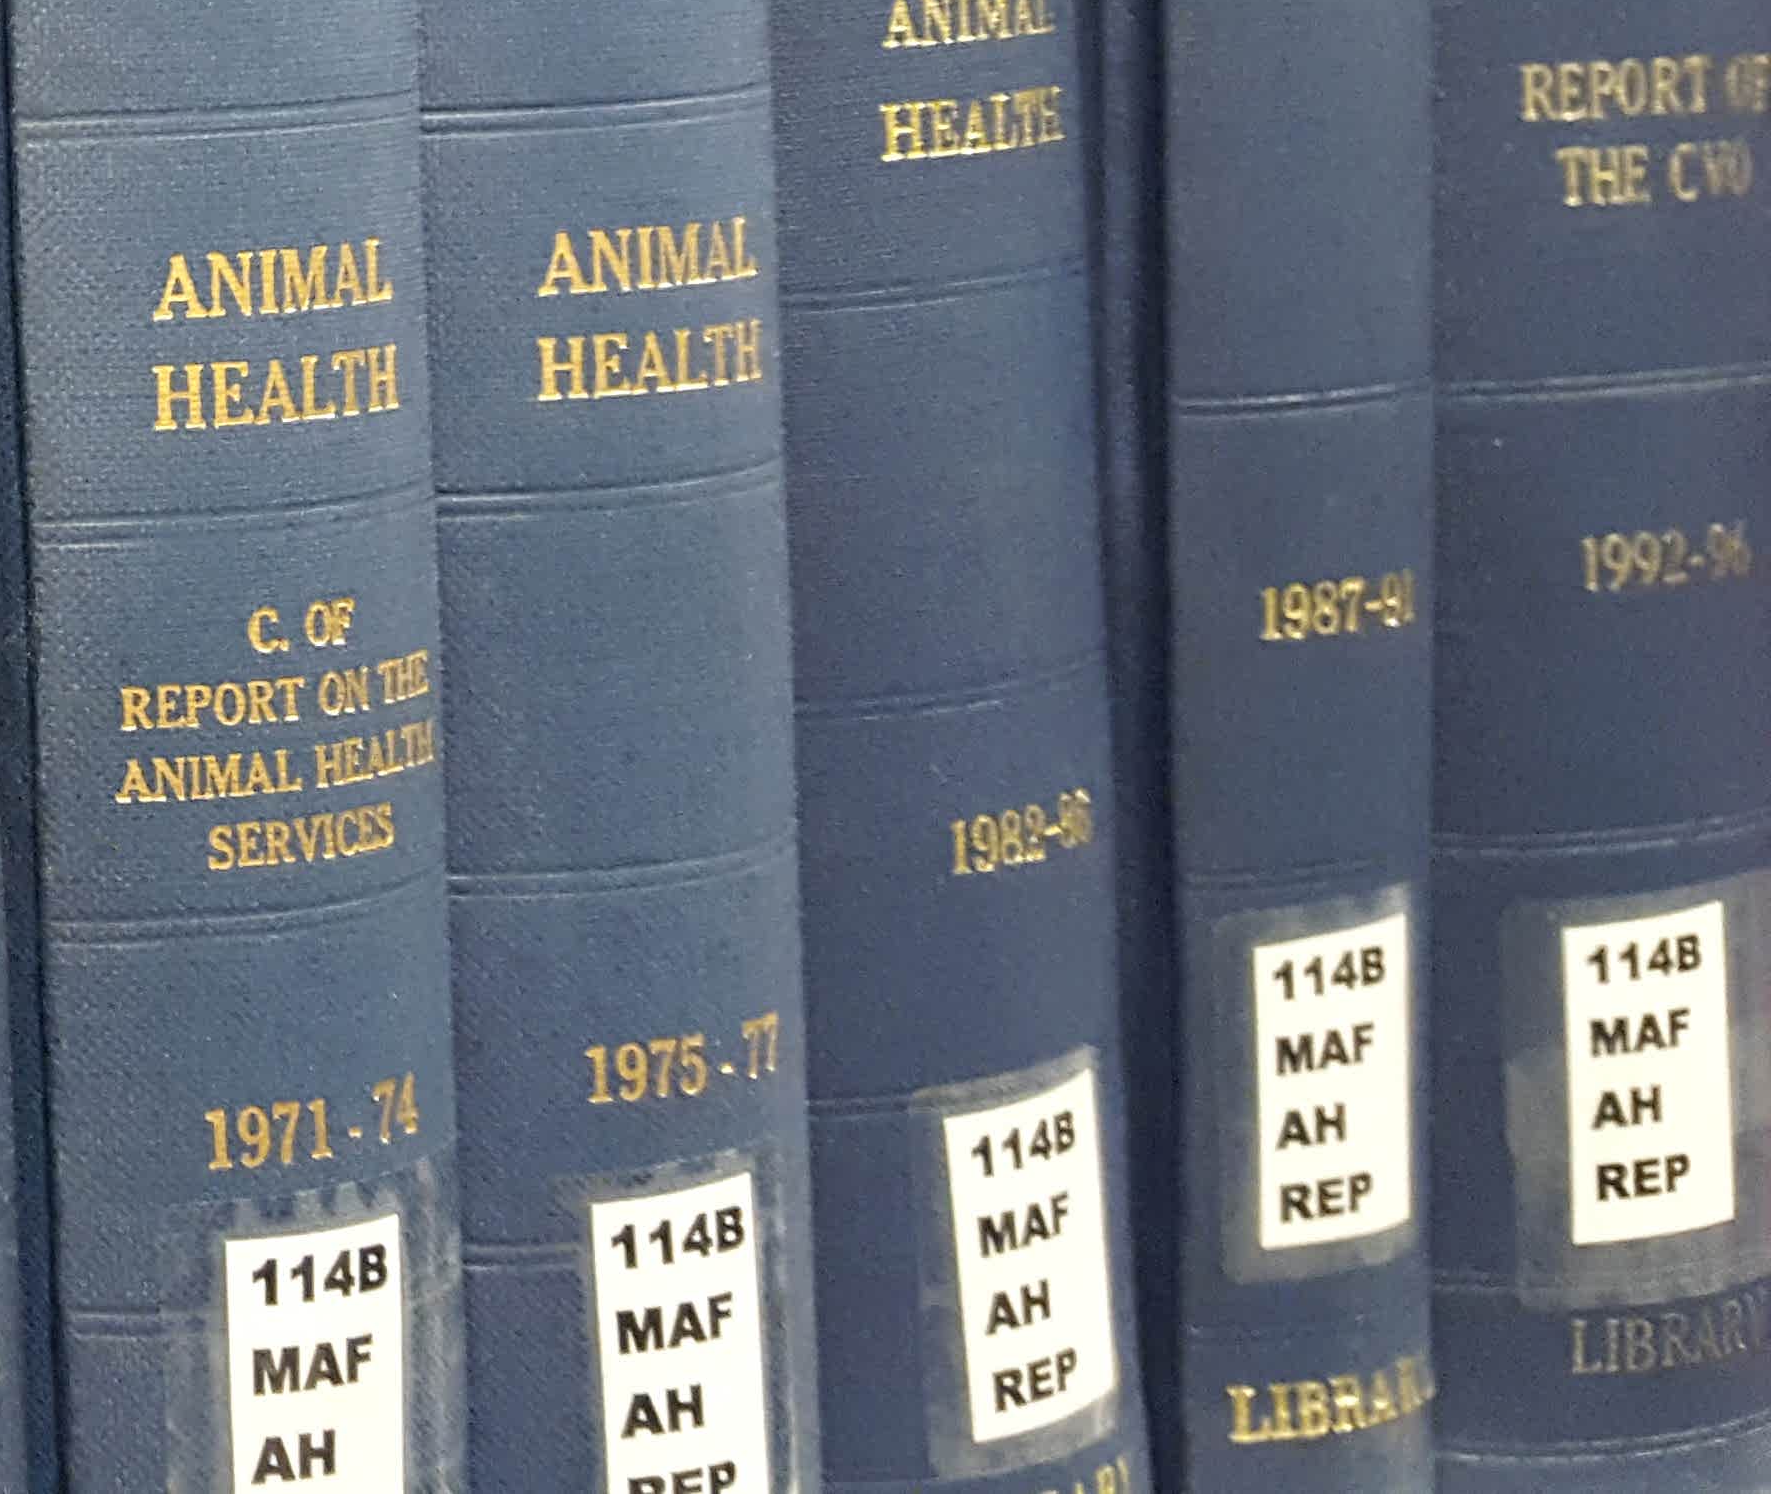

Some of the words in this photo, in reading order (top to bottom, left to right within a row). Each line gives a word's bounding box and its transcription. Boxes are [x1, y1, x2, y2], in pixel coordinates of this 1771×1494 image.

[1518, 54, 1713, 123] REPORT
[877, 84, 1067, 163] HEALTH
[1554, 143, 1653, 208] THE
[151, 236, 396, 323] ANIMAL
[536, 212, 760, 298] ANIMAL
[150, 342, 401, 433] HEALTH
[535, 317, 764, 402] HEALTH
[246, 604, 291, 654] C.
[303, 596, 356, 649] OF
[119, 675, 307, 733] REPORT
[316, 664, 371, 718] ON
[377, 648, 430, 706] THE
[113, 747, 305, 805] ANIMAL
[313, 718, 436, 790] HEALTH
[206, 800, 396, 872] SERVICES
[1272, 944, 1387, 1003] 114B
[1586, 933, 1704, 985] 114B
[1274, 1021, 1376, 1078] MAF
[1589, 1007, 1692, 1060] MAF
[1275, 1102, 1348, 1151] AH
[1591, 1084, 1663, 1132] AH
[970, 1109, 1077, 1178] 114B
[1278, 1171, 1375, 1225] REP
[1595, 1152, 1692, 1203] REP
[610, 1205, 746, 1271] 114B
[976, 1190, 1070, 1259] MAF
[251, 1242, 389, 1307] 114B
[984, 1277, 1052, 1337] AH
[614, 1291, 734, 1356] MAF
[252, 1332, 374, 1398] MAF
[991, 1346, 1078, 1414] REP
[619, 1381, 706, 1440] AH
[1224, 1353, 1437, 1445] LIBRAR
[250, 1428, 337, 1486] AH
